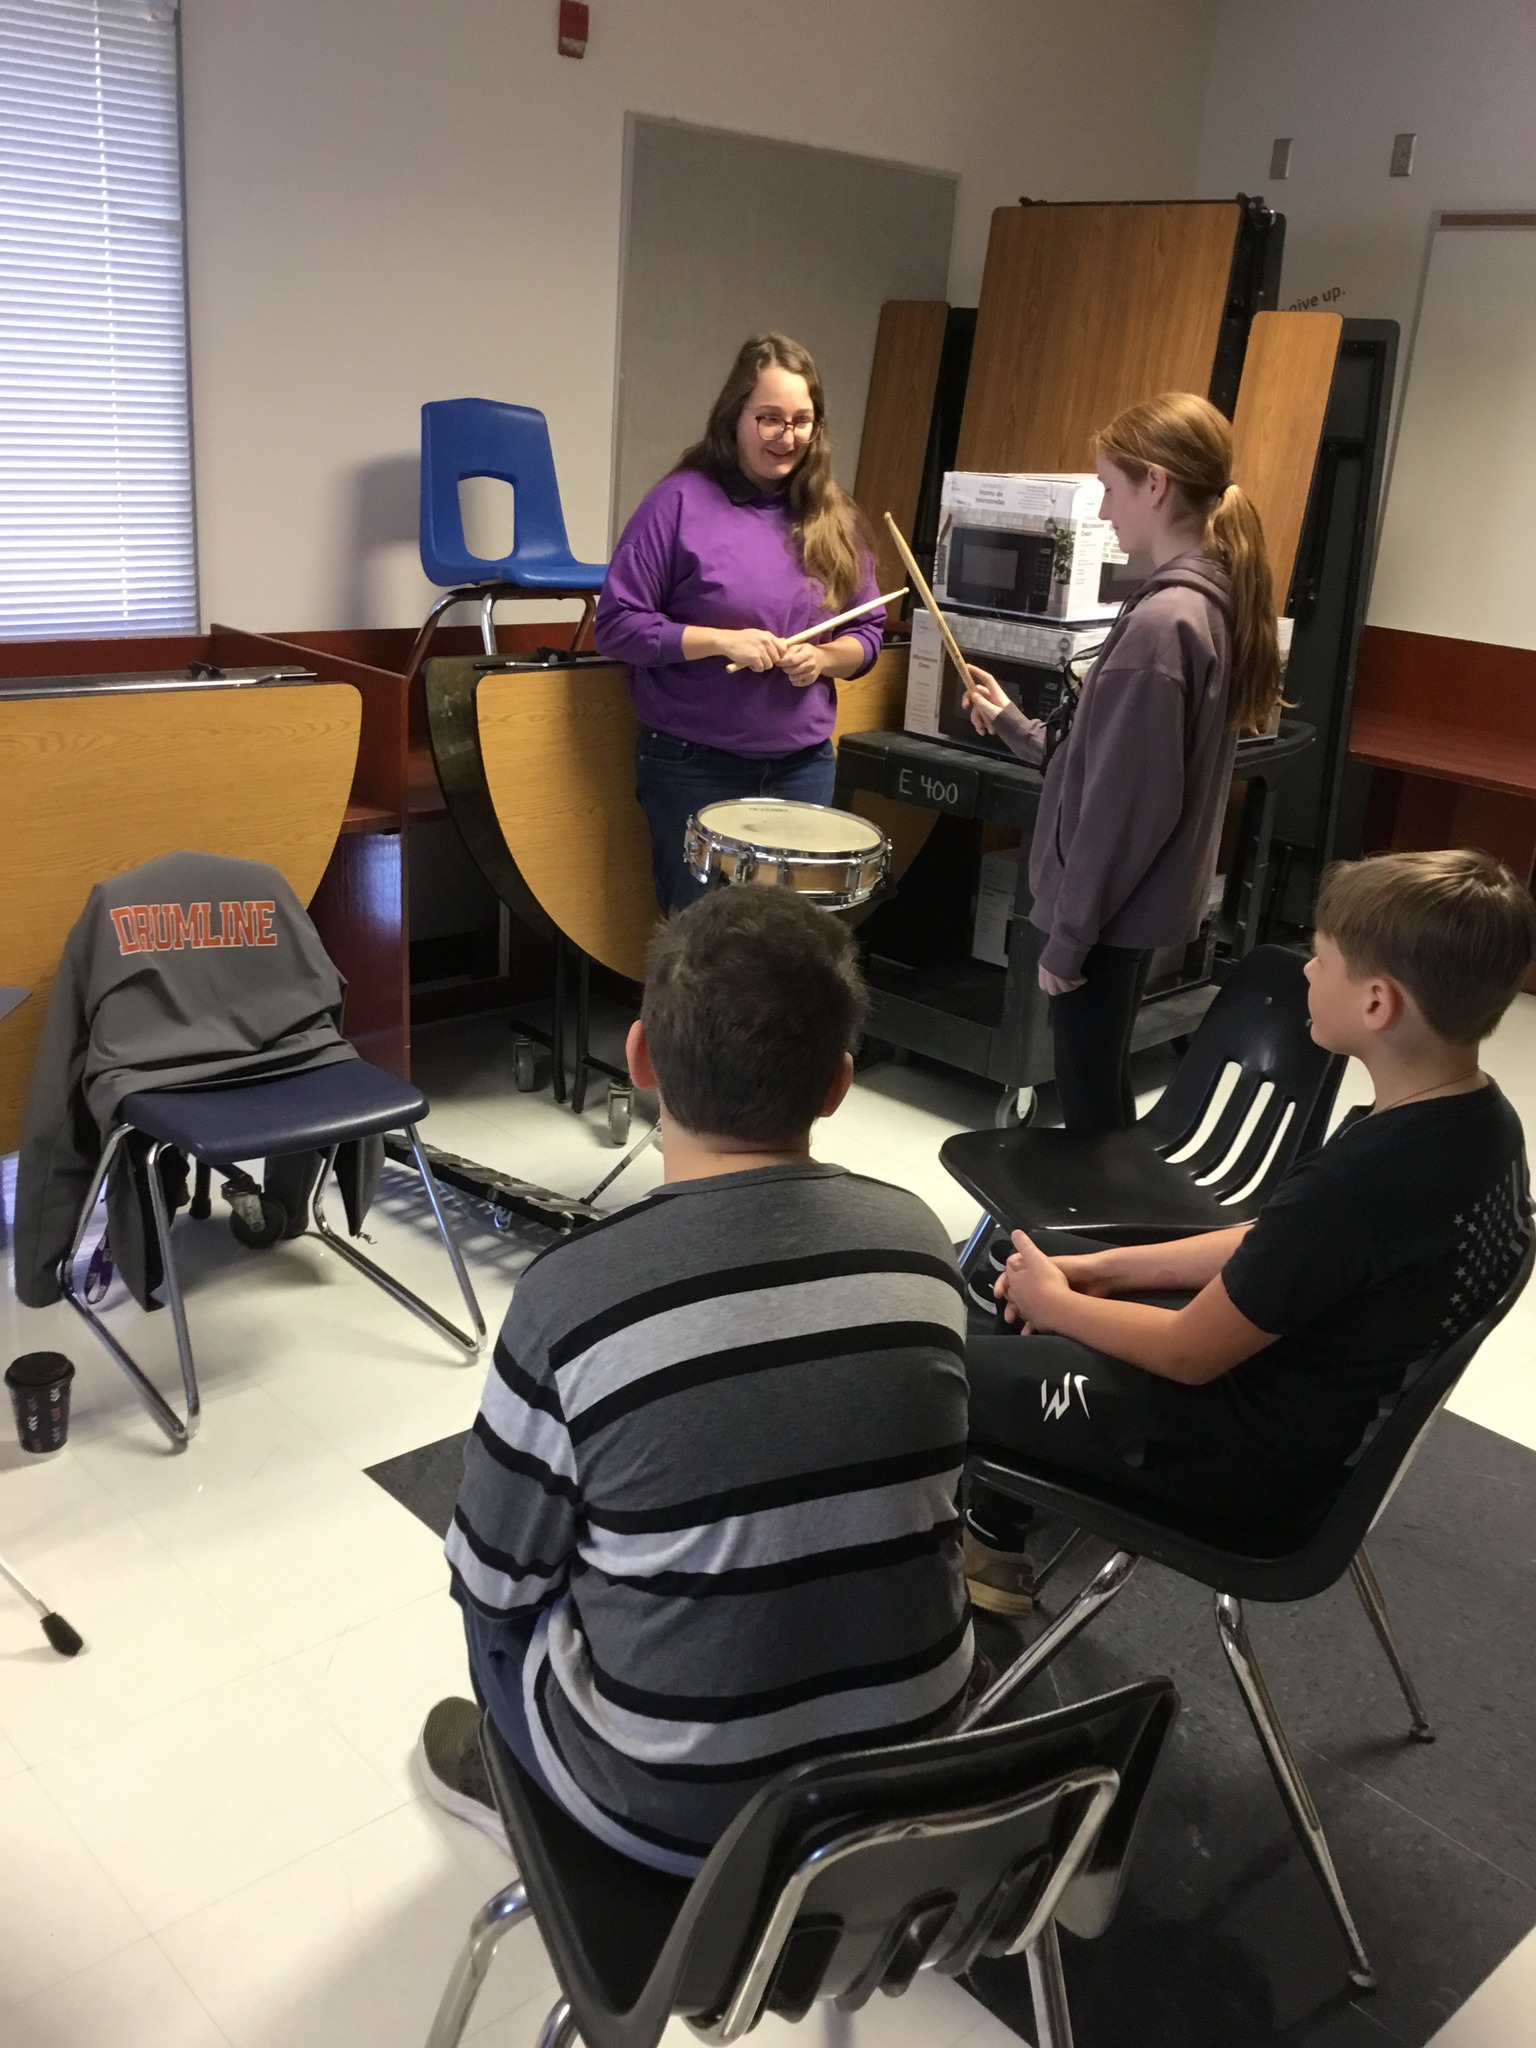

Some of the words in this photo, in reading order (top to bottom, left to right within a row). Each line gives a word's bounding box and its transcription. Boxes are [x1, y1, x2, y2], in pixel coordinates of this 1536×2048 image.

[1322, 287, 1346, 302] up.
[899, 768, 914, 796] E
[921, 774, 959, 804] 400
[110, 900, 278, 956] DRUMLINE
